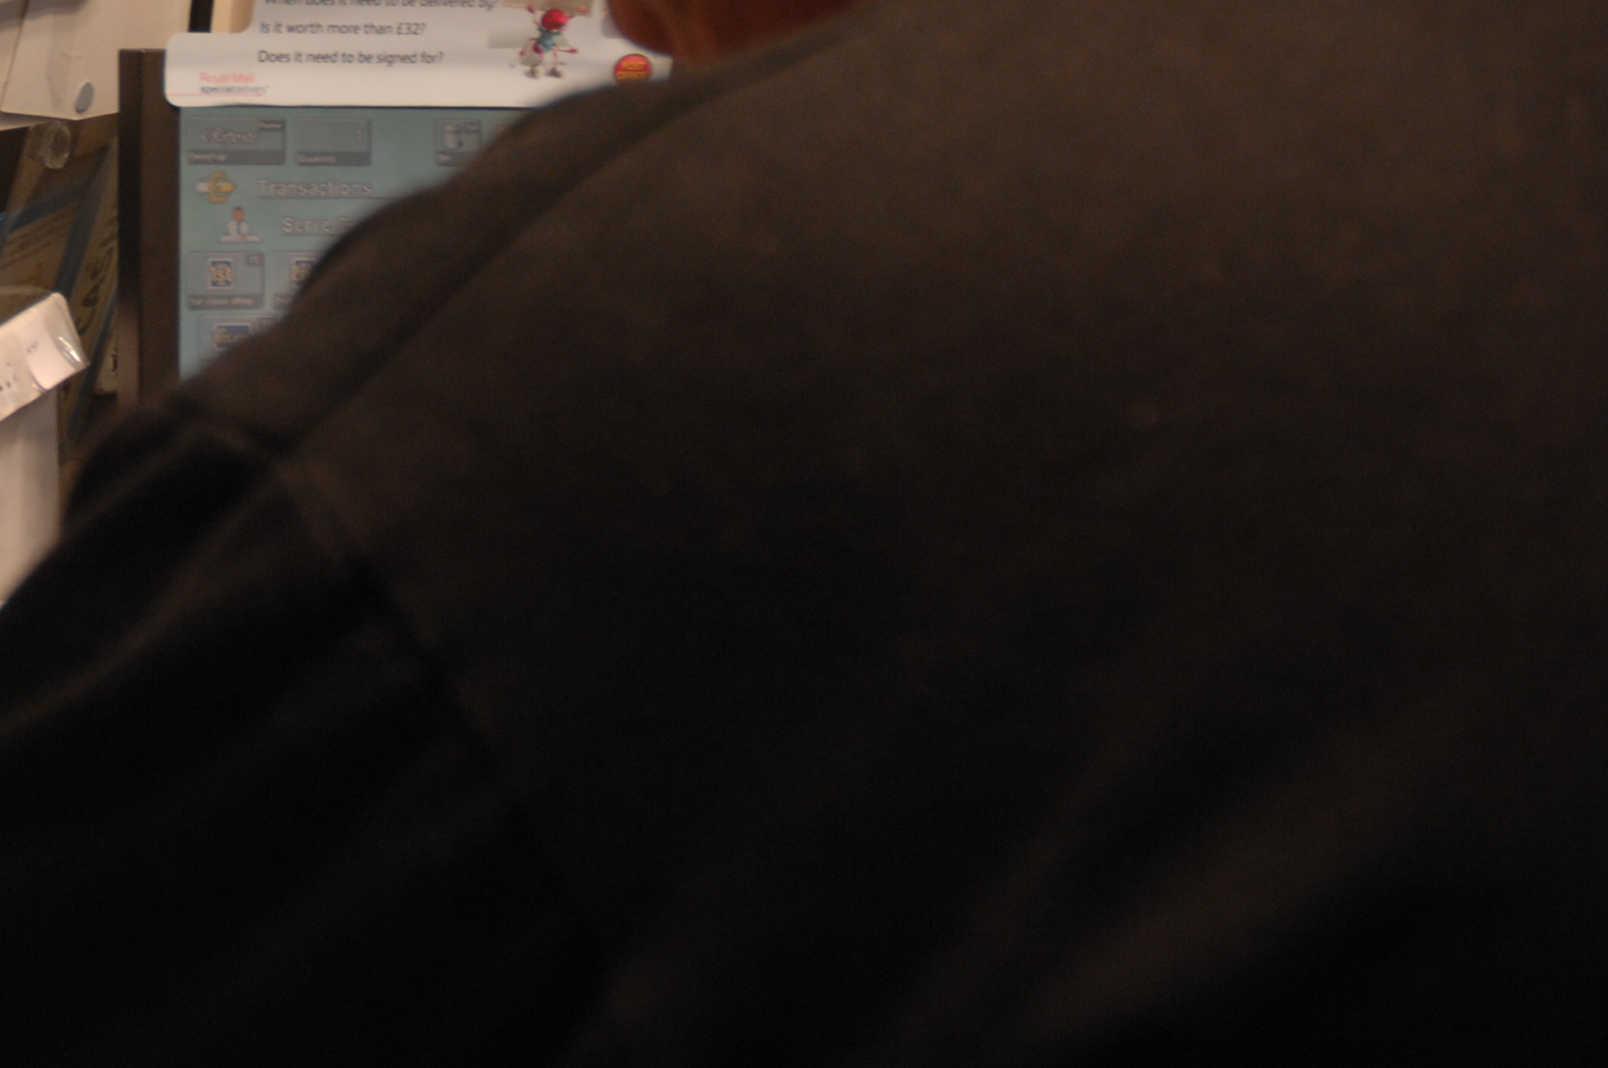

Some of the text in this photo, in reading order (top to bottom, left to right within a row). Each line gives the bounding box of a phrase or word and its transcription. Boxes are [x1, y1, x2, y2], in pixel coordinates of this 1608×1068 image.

[259, 22, 427, 36] Is it worth more than £32?
[258, 50, 445, 67] Does it need to be signed for?
[199, 72, 256, 84] Royal Mail
[258, 180, 373, 196] Transactions
[282, 217, 331, 232] Serve
